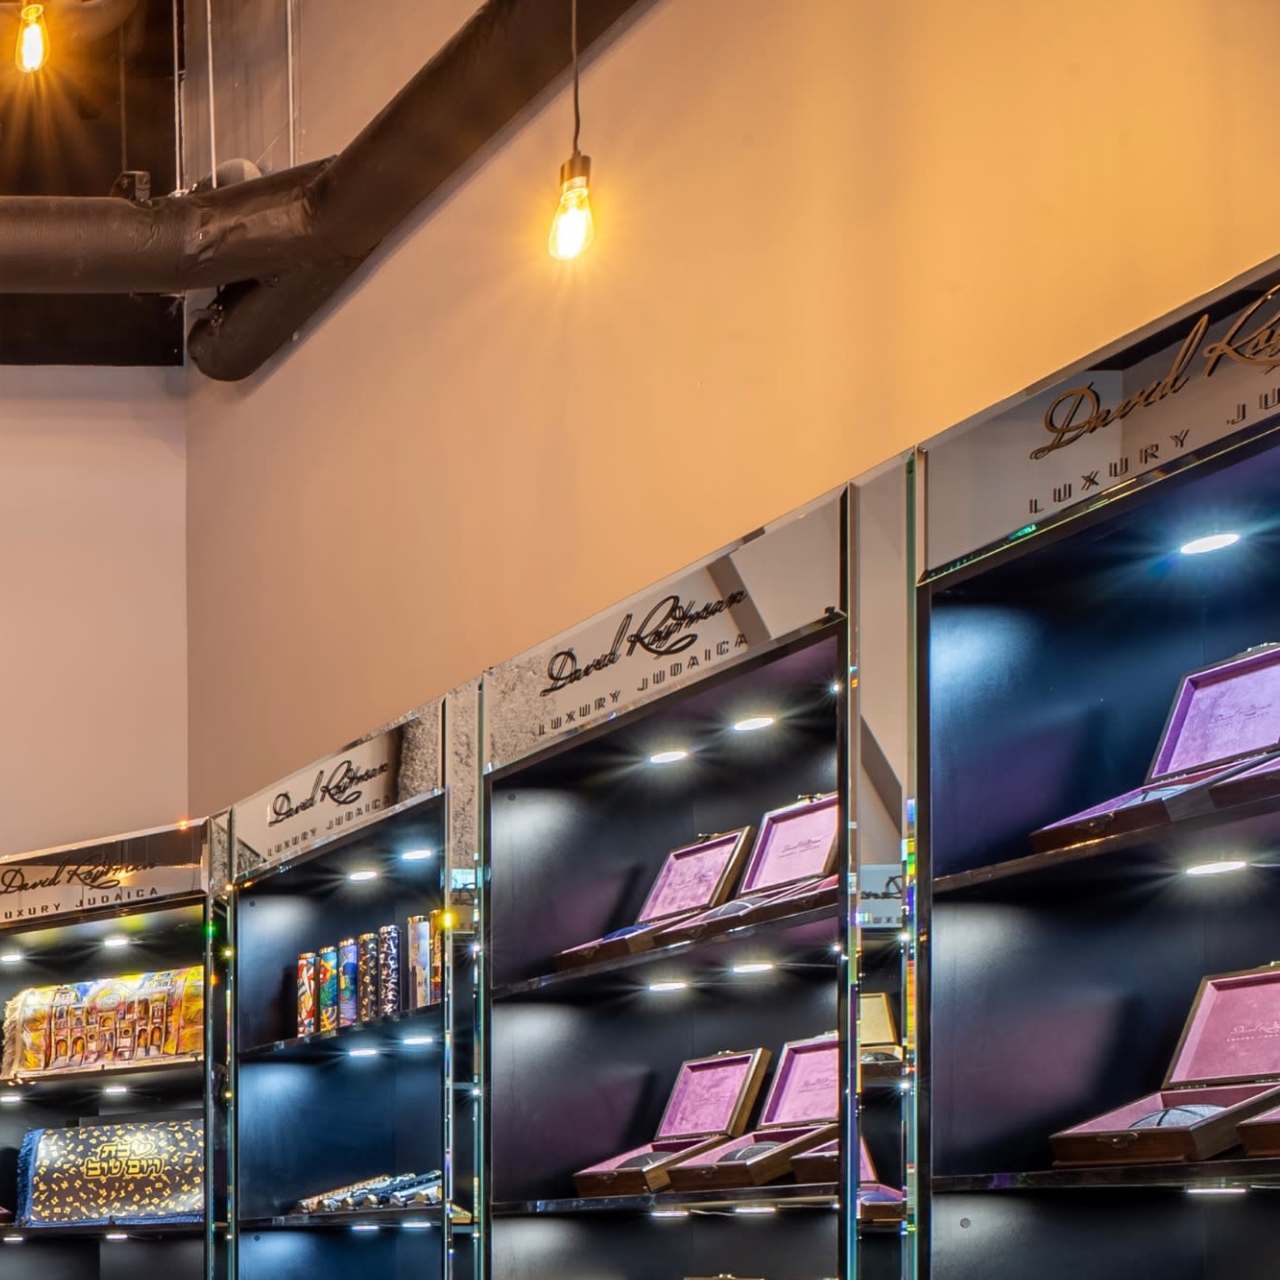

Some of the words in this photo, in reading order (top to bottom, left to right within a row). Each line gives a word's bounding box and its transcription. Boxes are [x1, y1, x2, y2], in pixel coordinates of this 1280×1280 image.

[1028, 312, 1210, 461] David
[1028, 429, 1190, 515] LUXURY
[539, 612, 634, 698] David
[539, 690, 621, 736] LUXURY
[636, 633, 749, 692] JUDAICA
[267, 827, 317, 857] LUXURY
[325, 794, 392, 830] JUDAICA
[74, 886, 159, 908] JUDAICA
